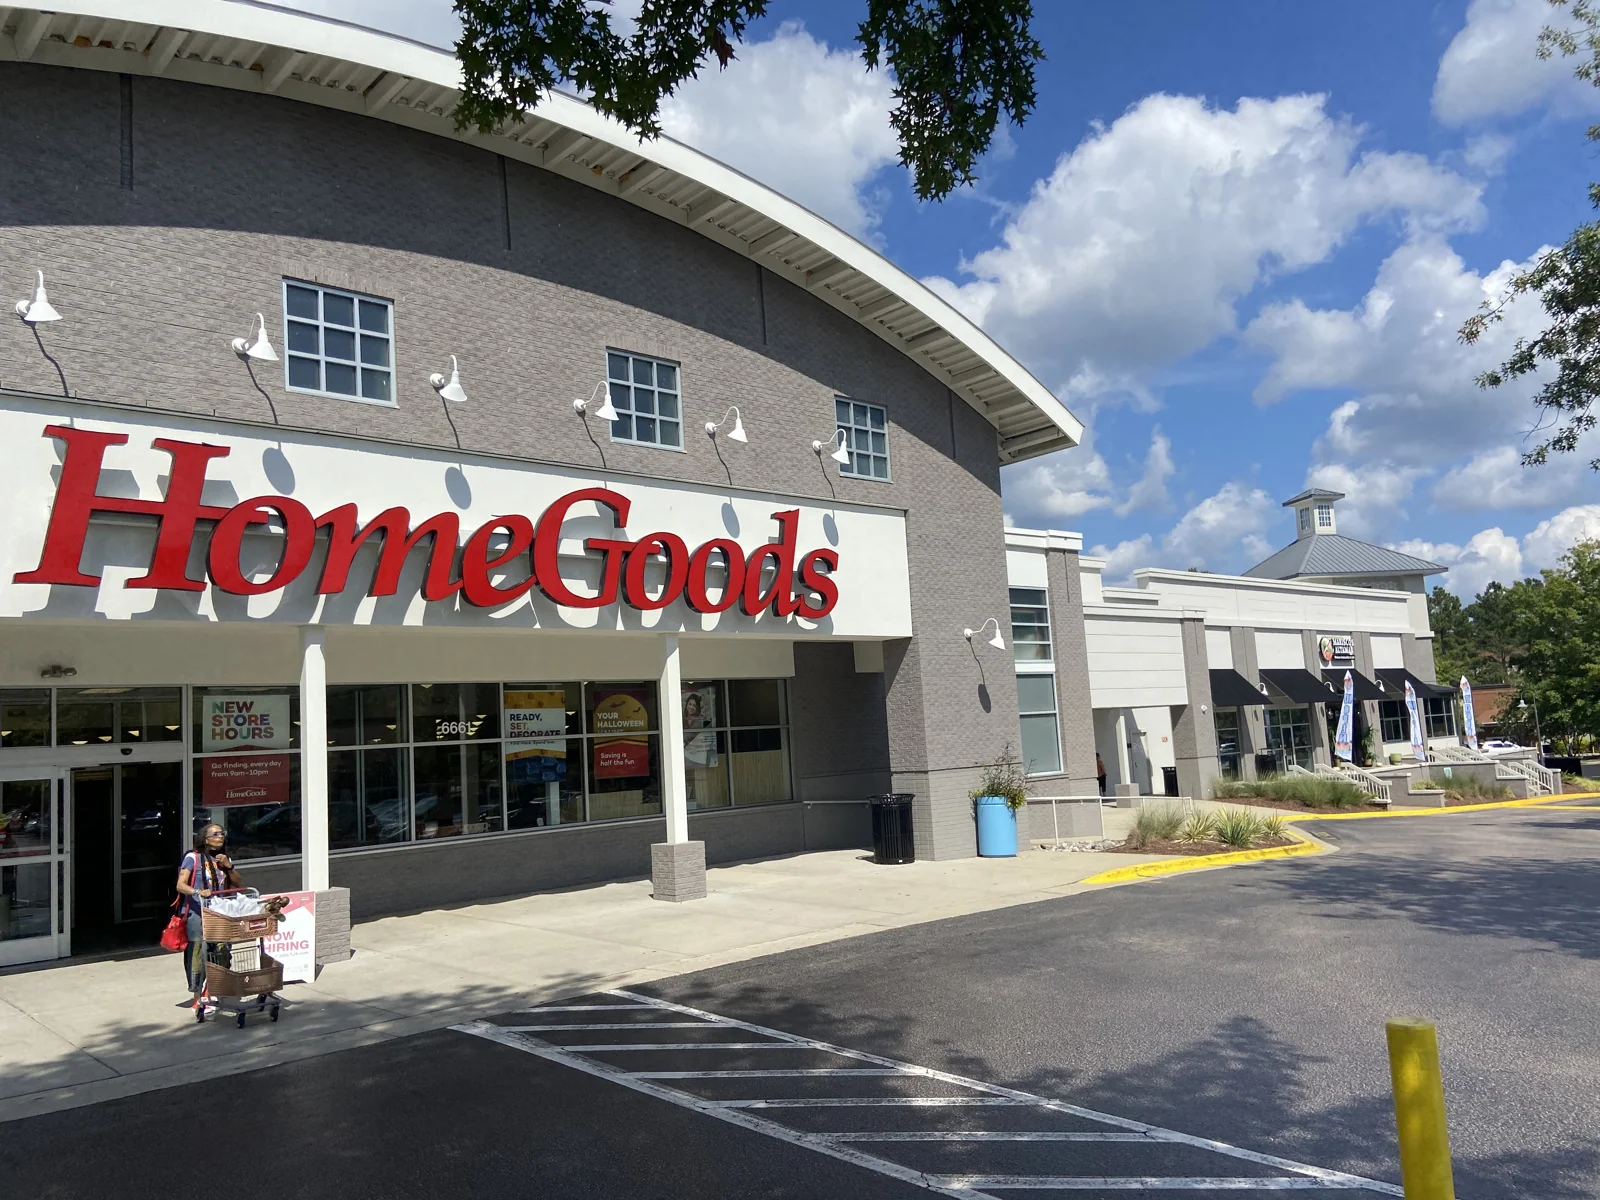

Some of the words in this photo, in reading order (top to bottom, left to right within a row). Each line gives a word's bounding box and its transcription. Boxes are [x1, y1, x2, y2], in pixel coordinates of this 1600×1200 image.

[14, 424, 839, 619] HomeGoods
[211, 701, 254, 714] NEW
[211, 714, 270, 727] STORE
[509, 713, 543, 721] READY,
[441, 721, 471, 735] 6661
[597, 720, 644, 728] HALLOWEEN
[211, 727, 274, 740] HOURS
[510, 730, 561, 738] DECORATE
[250, 761, 268, 769] every
[600, 759, 612, 767] half
[225, 788, 267, 799] HomeGoods
[263, 930, 295, 943] NOW
[264, 940, 310, 953] HIRING
